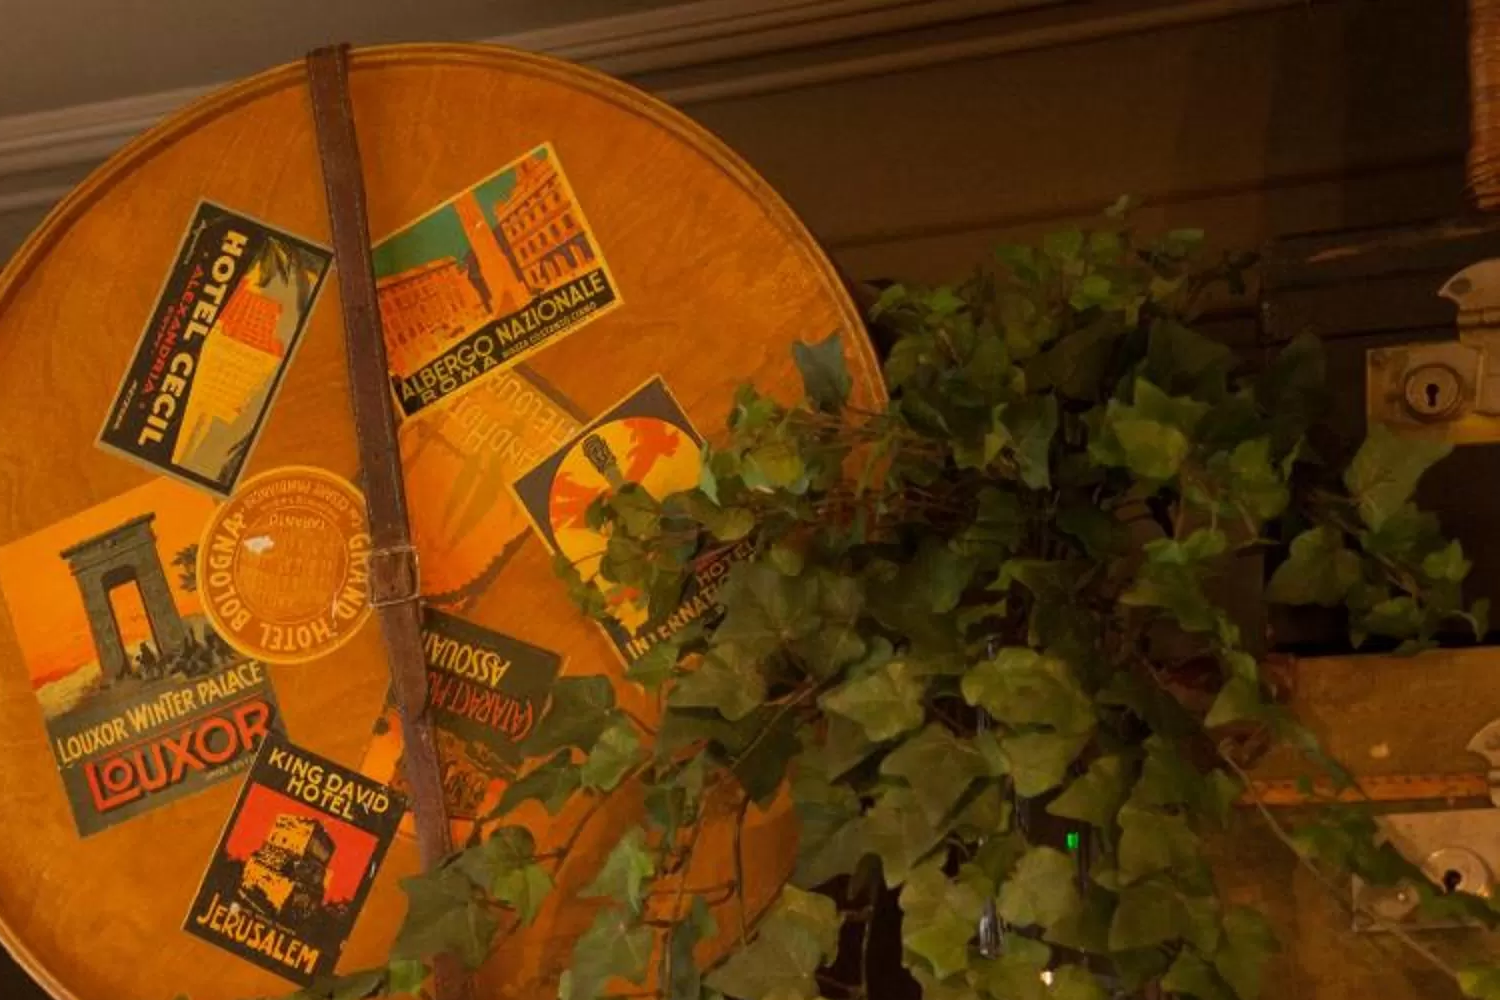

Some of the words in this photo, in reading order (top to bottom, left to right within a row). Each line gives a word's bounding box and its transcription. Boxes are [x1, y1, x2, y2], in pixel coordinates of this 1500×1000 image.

[144, 265, 204, 394] ALEXANDRIA
[183, 230, 247, 341] HOTEL
[401, 335, 494, 400] ALBERGO
[495, 271, 605, 345] NAZIONALE
[420, 356, 498, 405] ROMA
[137, 352, 194, 446] CECIL
[209, 514, 252, 632] BOLOGNA
[336, 532, 372, 620] GRAND
[259, 615, 333, 651] HOTEL
[57, 714, 129, 765] LOUXOR
[126, 690, 195, 733] WINTER
[198, 660, 264, 709] PALACE
[83, 699, 273, 812] LOUXOR
[268, 747, 324, 785] KING
[325, 773, 390, 816] DAVID
[286, 775, 357, 821] HOTEL
[196, 892, 320, 975] JERUSALEM
